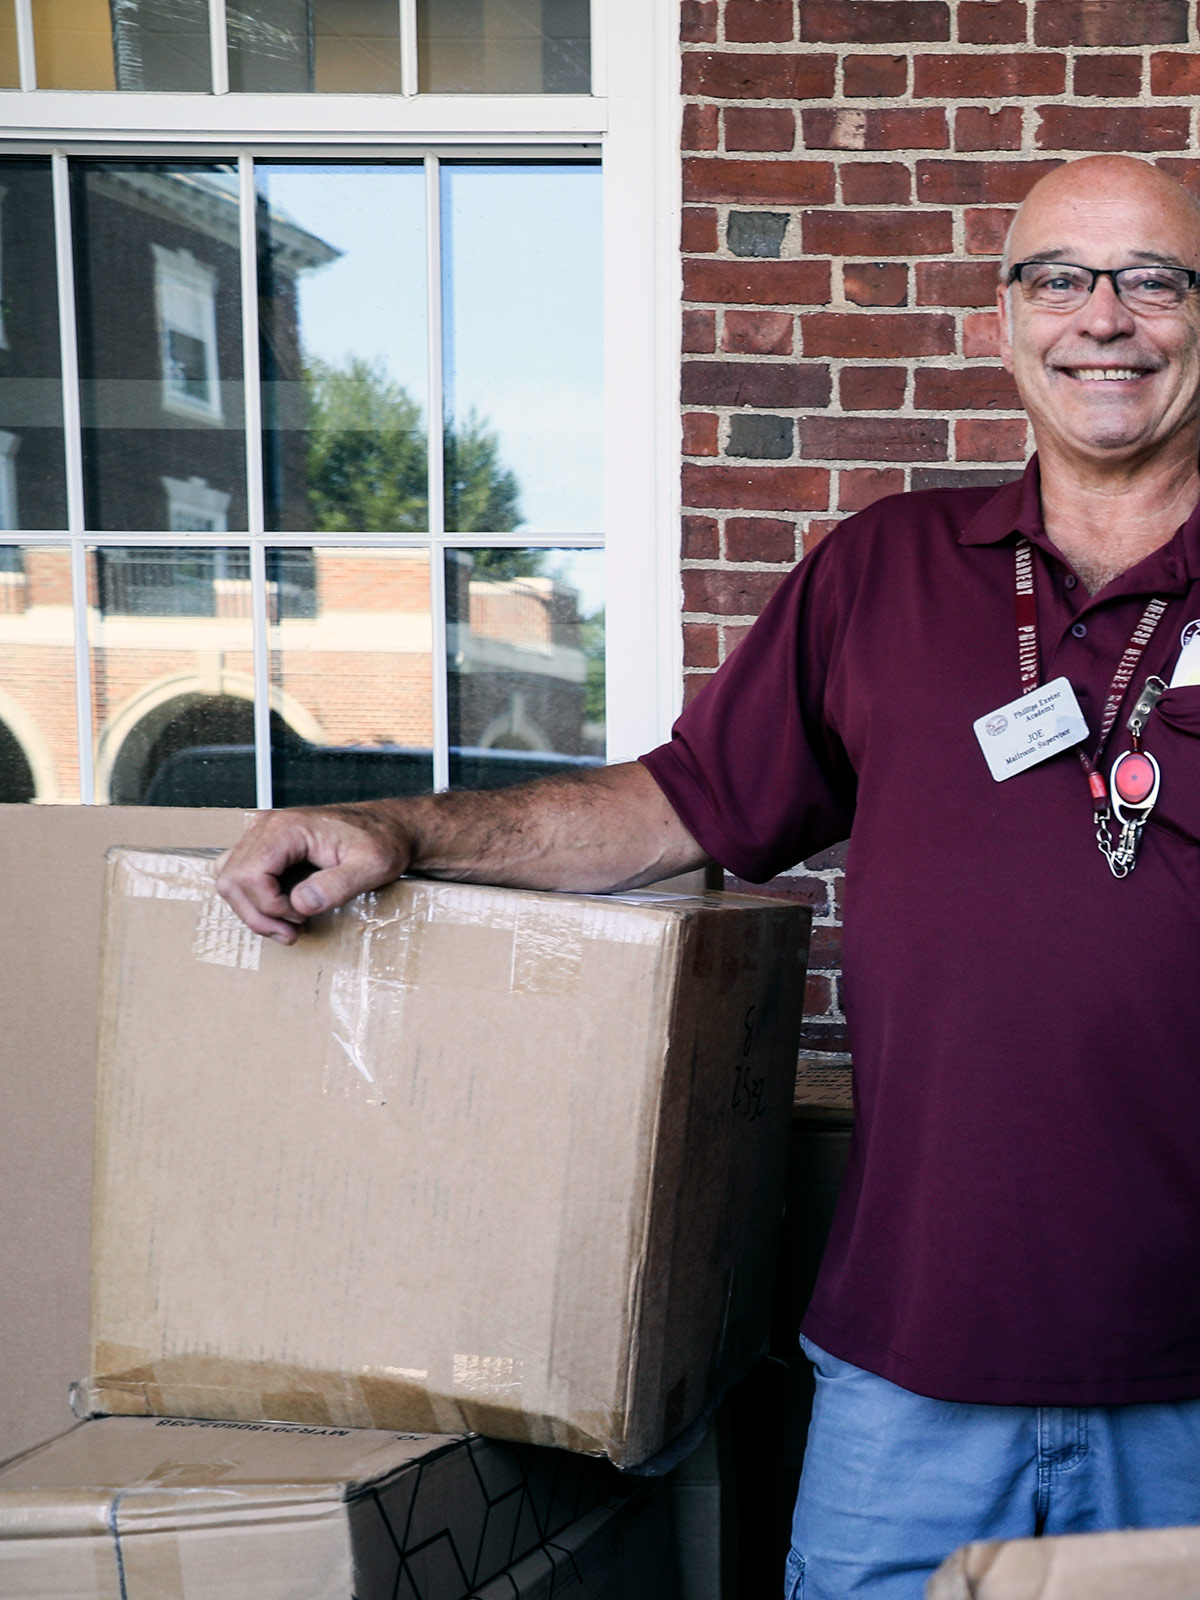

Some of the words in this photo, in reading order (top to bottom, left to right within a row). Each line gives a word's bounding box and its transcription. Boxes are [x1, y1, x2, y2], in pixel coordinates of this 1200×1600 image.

[1015, 547, 1034, 595] ACADEMY
[1018, 624, 1038, 681] PHILLIPS
[1111, 648, 1142, 689] EXETER
[1130, 598, 1168, 645] ACADEMY
[1013, 703, 1039, 720] Phillips
[1039, 691, 1061, 707] Exeter
[1026, 703, 1055, 722] Academy
[1005, 746, 1036, 765] Mailroom
[1037, 728, 1071, 748] Supervisor
[1027, 729, 1044, 743] JOE
